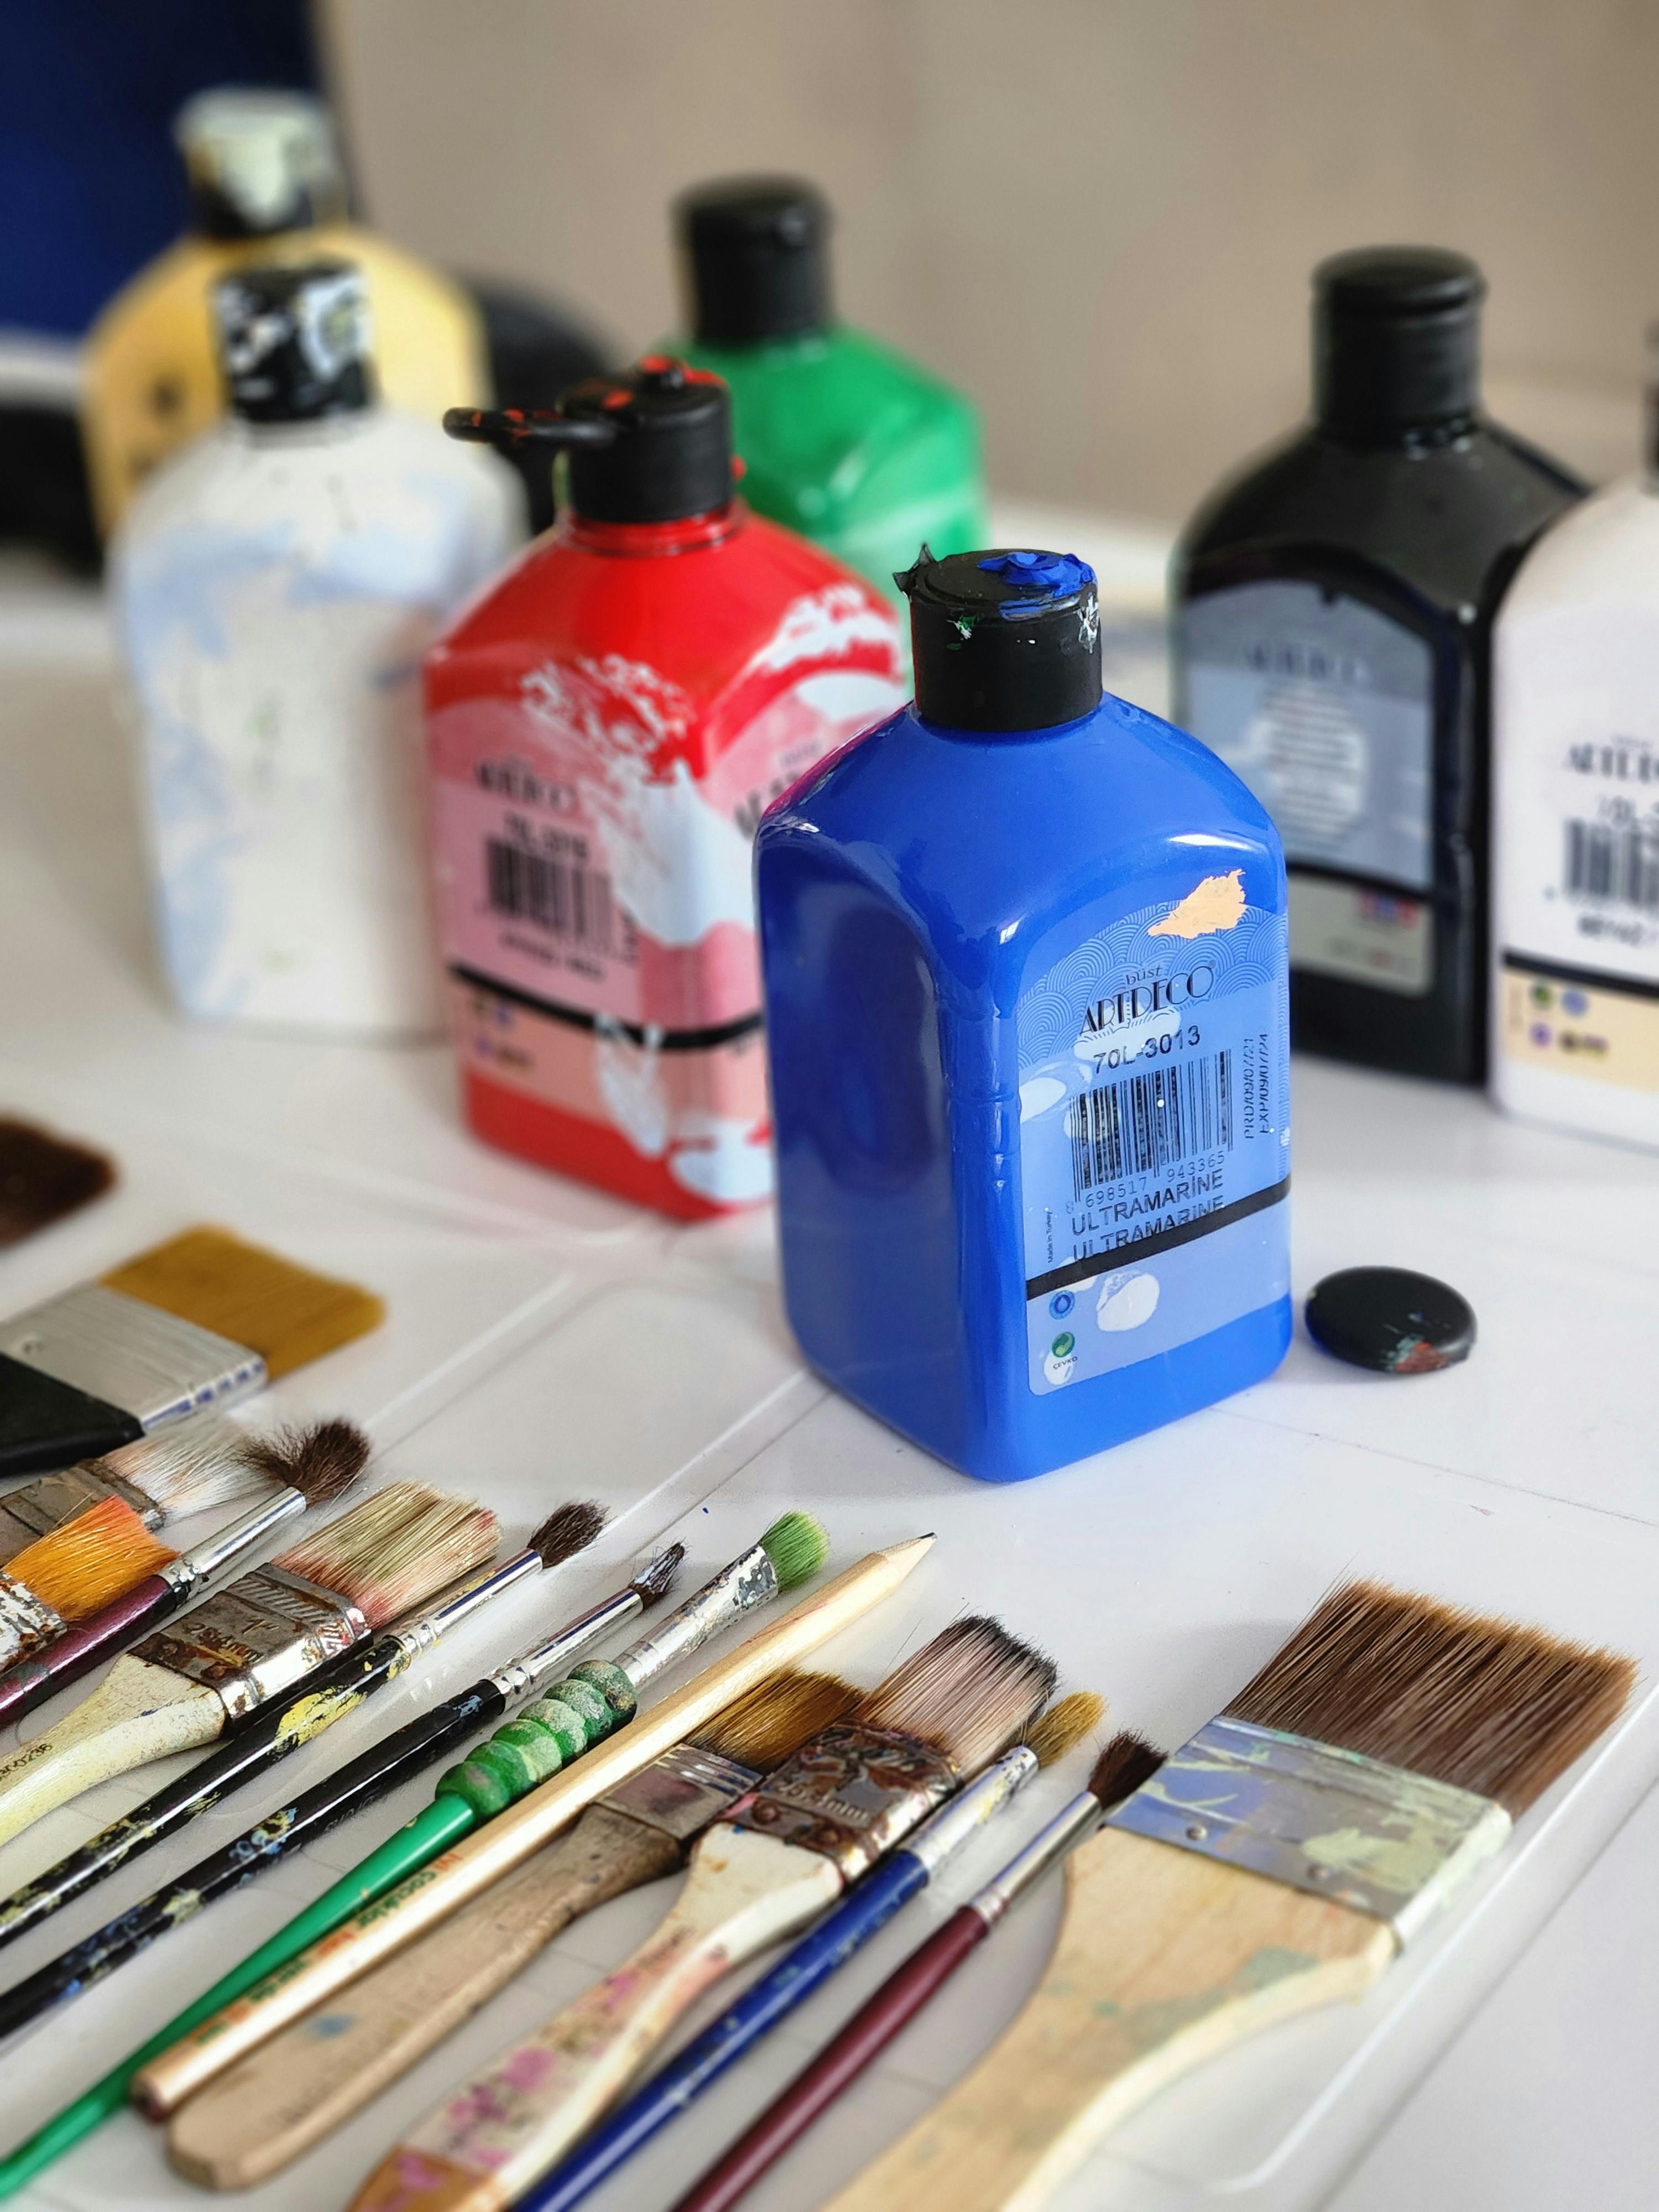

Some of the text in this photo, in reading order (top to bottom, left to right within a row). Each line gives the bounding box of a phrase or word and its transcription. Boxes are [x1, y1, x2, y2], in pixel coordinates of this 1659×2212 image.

[1125, 963, 1163, 985] büst
[1079, 966, 1214, 1037] ARTDECO
[1093, 1025, 1201, 1074] 70L-3013
[1085, 1176, 1147, 1208] 698517
[1166, 1150, 1225, 1183] 943365
